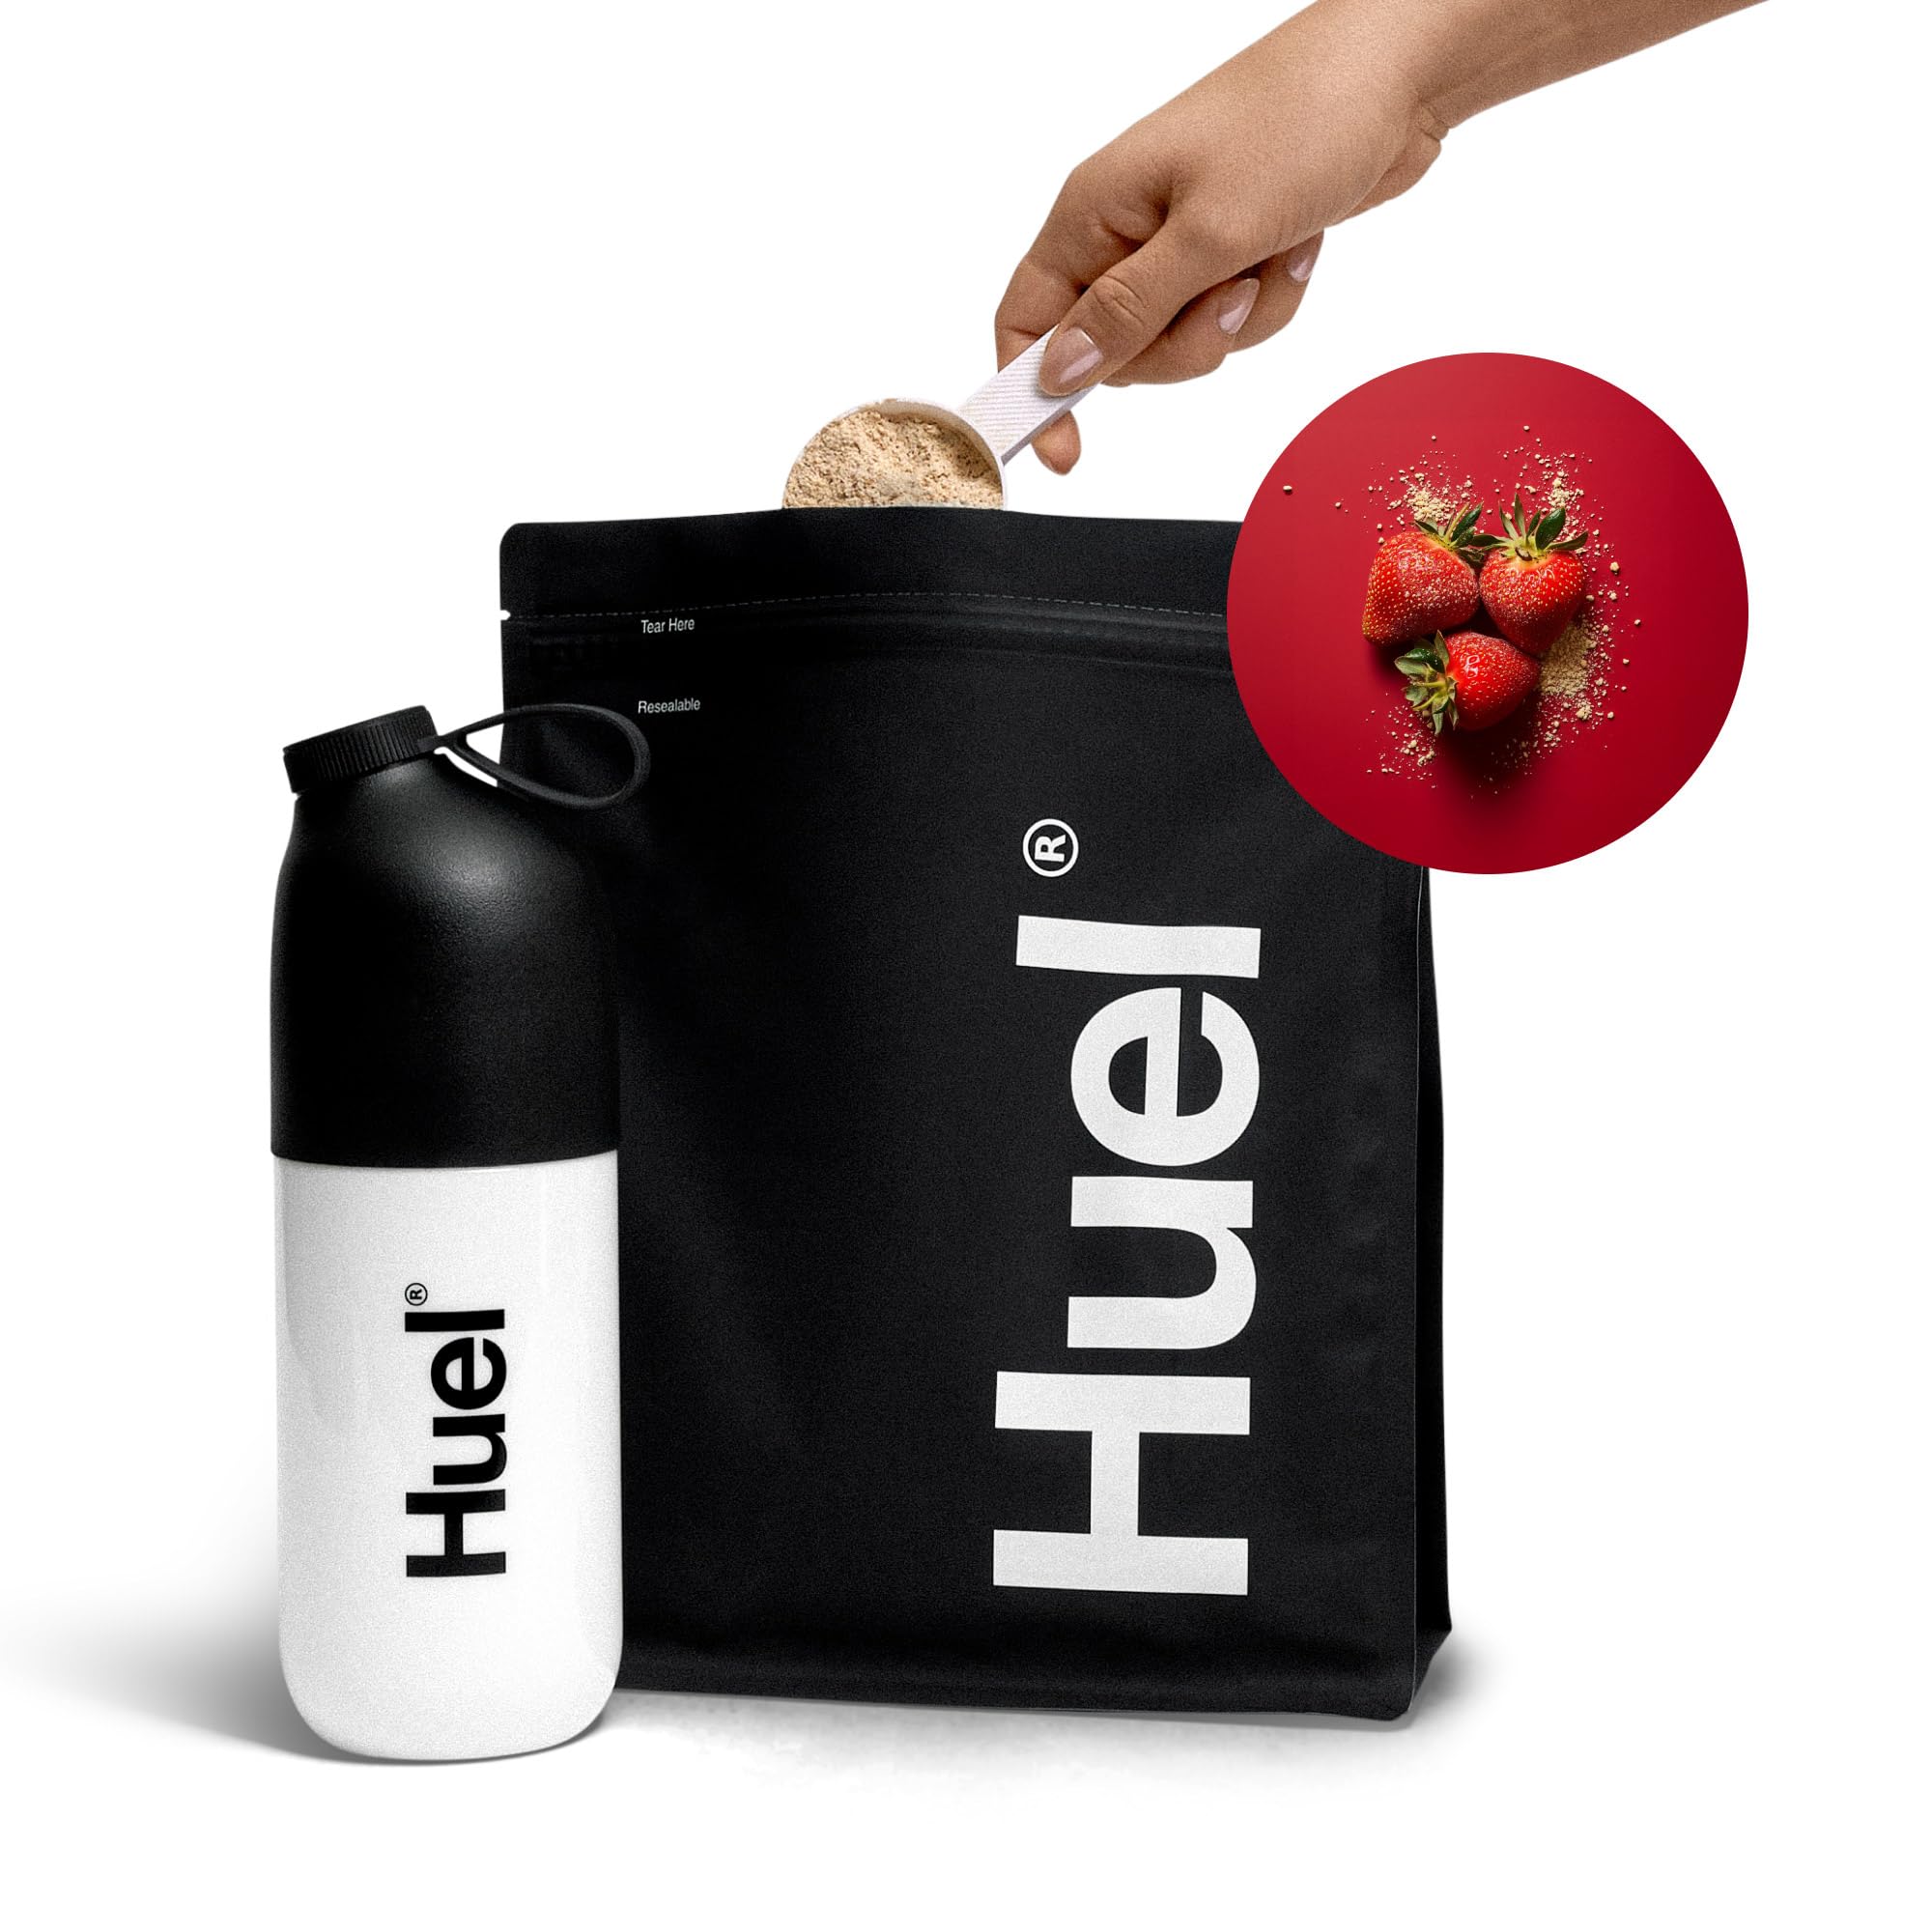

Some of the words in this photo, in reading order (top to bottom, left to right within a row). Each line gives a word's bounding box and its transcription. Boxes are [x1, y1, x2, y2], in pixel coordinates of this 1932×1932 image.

[640, 619, 666, 634] Tear
[668, 617, 696, 632] Here
[638, 697, 701, 714] Resealable
